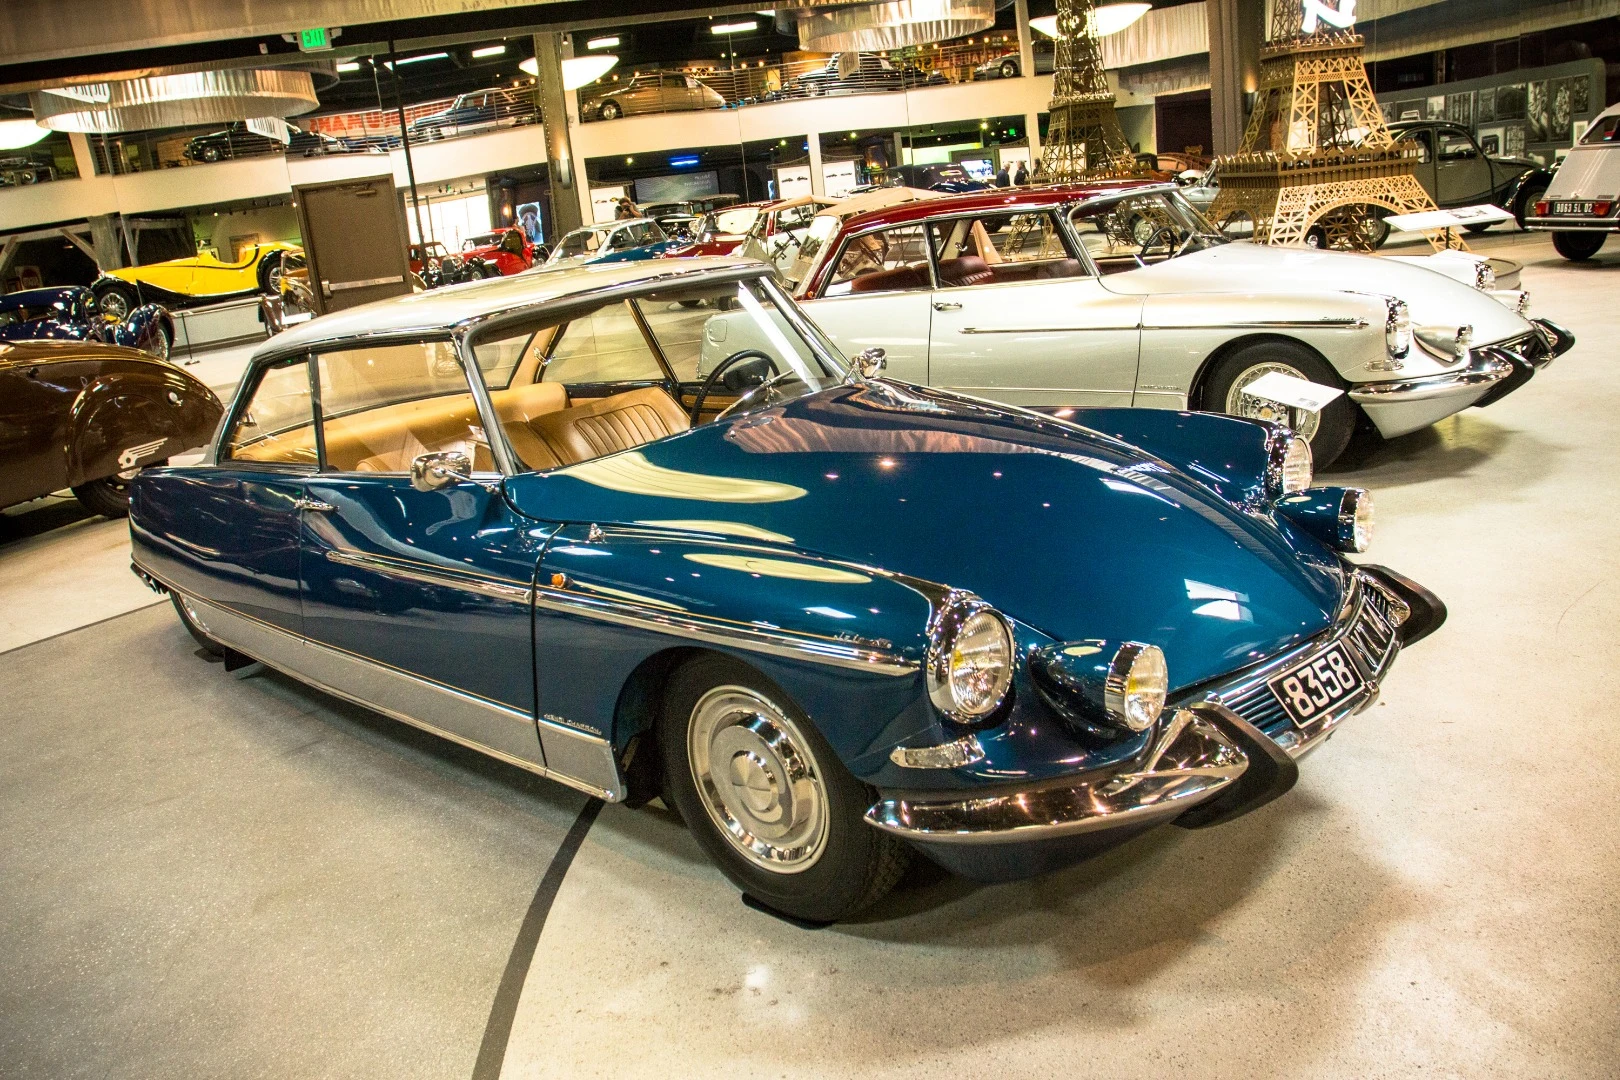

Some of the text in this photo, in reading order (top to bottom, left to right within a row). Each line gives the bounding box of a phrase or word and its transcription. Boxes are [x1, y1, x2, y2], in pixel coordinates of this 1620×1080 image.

[301, 27, 326, 48] EXIT
[1573, 203, 1581, 213] SL
[1584, 203, 1593, 213] 02
[1283, 650, 1356, 717] 8358
